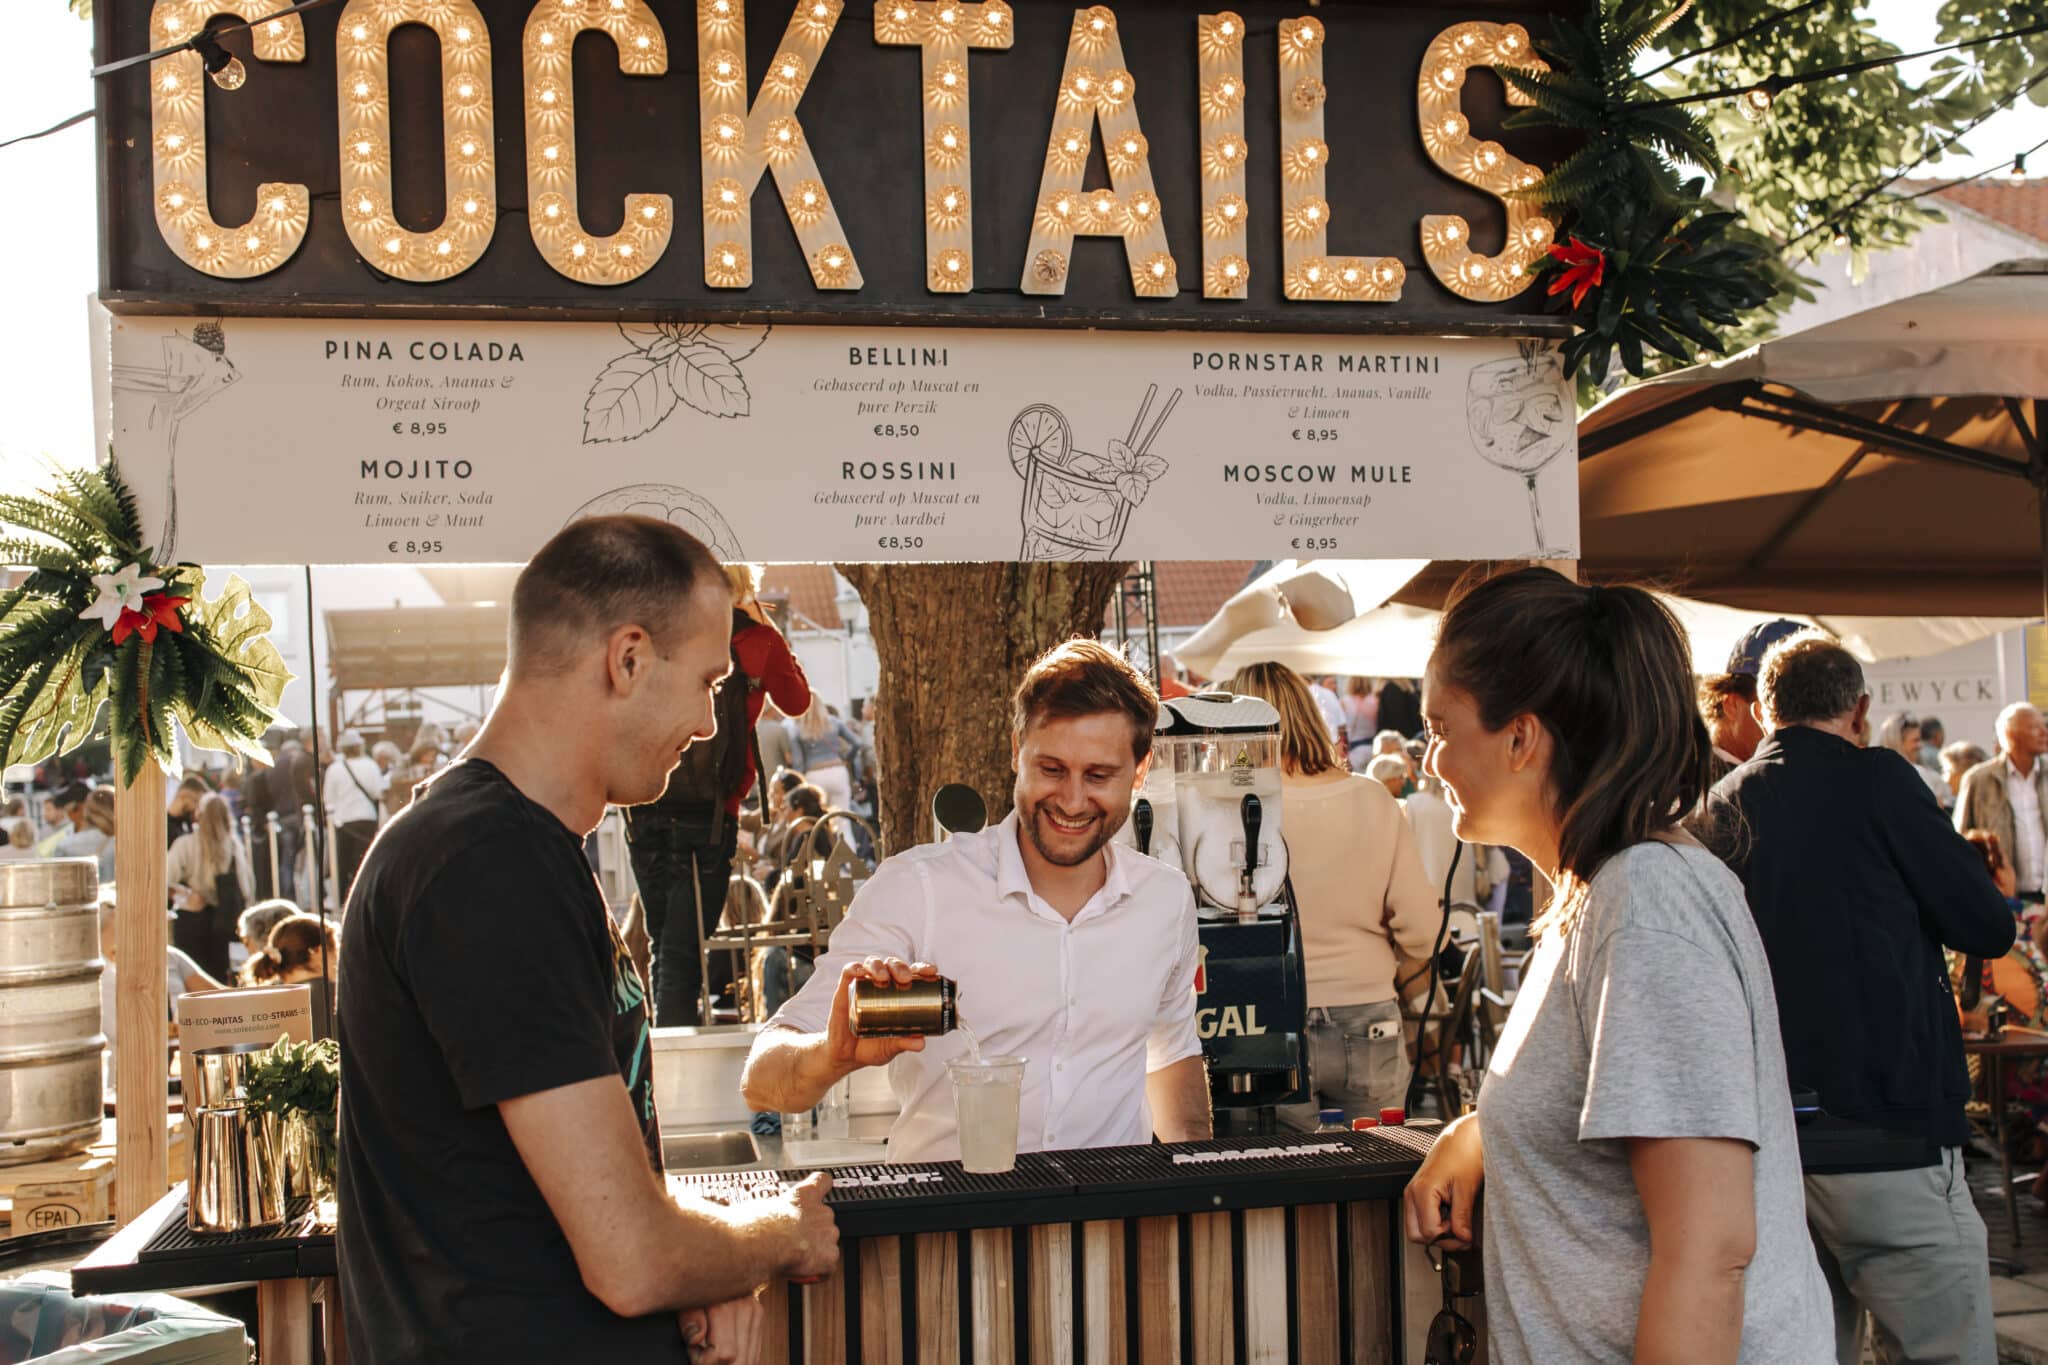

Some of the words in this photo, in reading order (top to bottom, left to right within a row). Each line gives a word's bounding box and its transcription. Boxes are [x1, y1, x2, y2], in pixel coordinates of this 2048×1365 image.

[150, 0, 1556, 303] COCKTAILS
[326, 341, 392, 359] PINA
[410, 342, 524, 361] COLADA
[850, 347, 947, 366] BELLINI
[1193, 352, 1323, 371] PORNSTAR
[1339, 355, 1439, 373] MARTINI
[341, 374, 380, 388] Rum,
[387, 375, 434, 389] Kokos,
[440, 376, 495, 388] Ananas
[501, 376, 515, 388] &
[814, 378, 884, 392] Gebaseerd
[889, 379, 905, 394] op
[911, 379, 959, 392] Muscat
[964, 383, 979, 393] en
[1195, 384, 1237, 399] Vodka,
[1243, 385, 1328, 399] Passievrucht,
[1333, 387, 1382, 400] Ananas,
[1388, 386, 1432, 400] Vanille
[377, 397, 426, 412] Orgeat
[432, 397, 480, 413] Siroop
[857, 401, 889, 415] pure
[895, 400, 938, 414] Perzik
[1288, 406, 1300, 419] &
[1304, 406, 1350, 419] Limoen
[393, 423, 403, 434] €
[411, 423, 447, 436] 8,95
[874, 425, 919, 437] €8,50
[1292, 430, 1301, 440] €
[1307, 430, 1338, 442] 8,95
[361, 460, 472, 479] MOJITO
[842, 462, 955, 480] ROSSINI
[1224, 465, 1335, 482] MOSCOW
[1352, 466, 1411, 483] MULE
[354, 491, 392, 505] Rum,
[400, 491, 451, 505] Suiker,
[458, 491, 493, 505] Soda
[814, 491, 885, 504] Gebaseerd
[889, 492, 905, 507] op
[911, 492, 959, 504] Muscat
[964, 494, 980, 504] en
[1256, 492, 1299, 506] Vodka,
[1304, 492, 1371, 508] Limoensap
[365, 514, 419, 527] Limoen
[426, 515, 440, 527] &
[447, 514, 484, 527] Munt
[855, 513, 887, 528] pure
[891, 512, 945, 526] Aardbei
[1273, 514, 1285, 526] &
[1289, 513, 1359, 528] Gingerbeer
[388, 542, 398, 553] €
[406, 542, 443, 554] 8,95
[878, 537, 923, 549] €8,50
[1291, 538, 1300, 549] €
[1306, 538, 1337, 550] 8,95
[1870, 679, 1993, 703] EWYCK
[35, 1211, 72, 1228] EPAL
